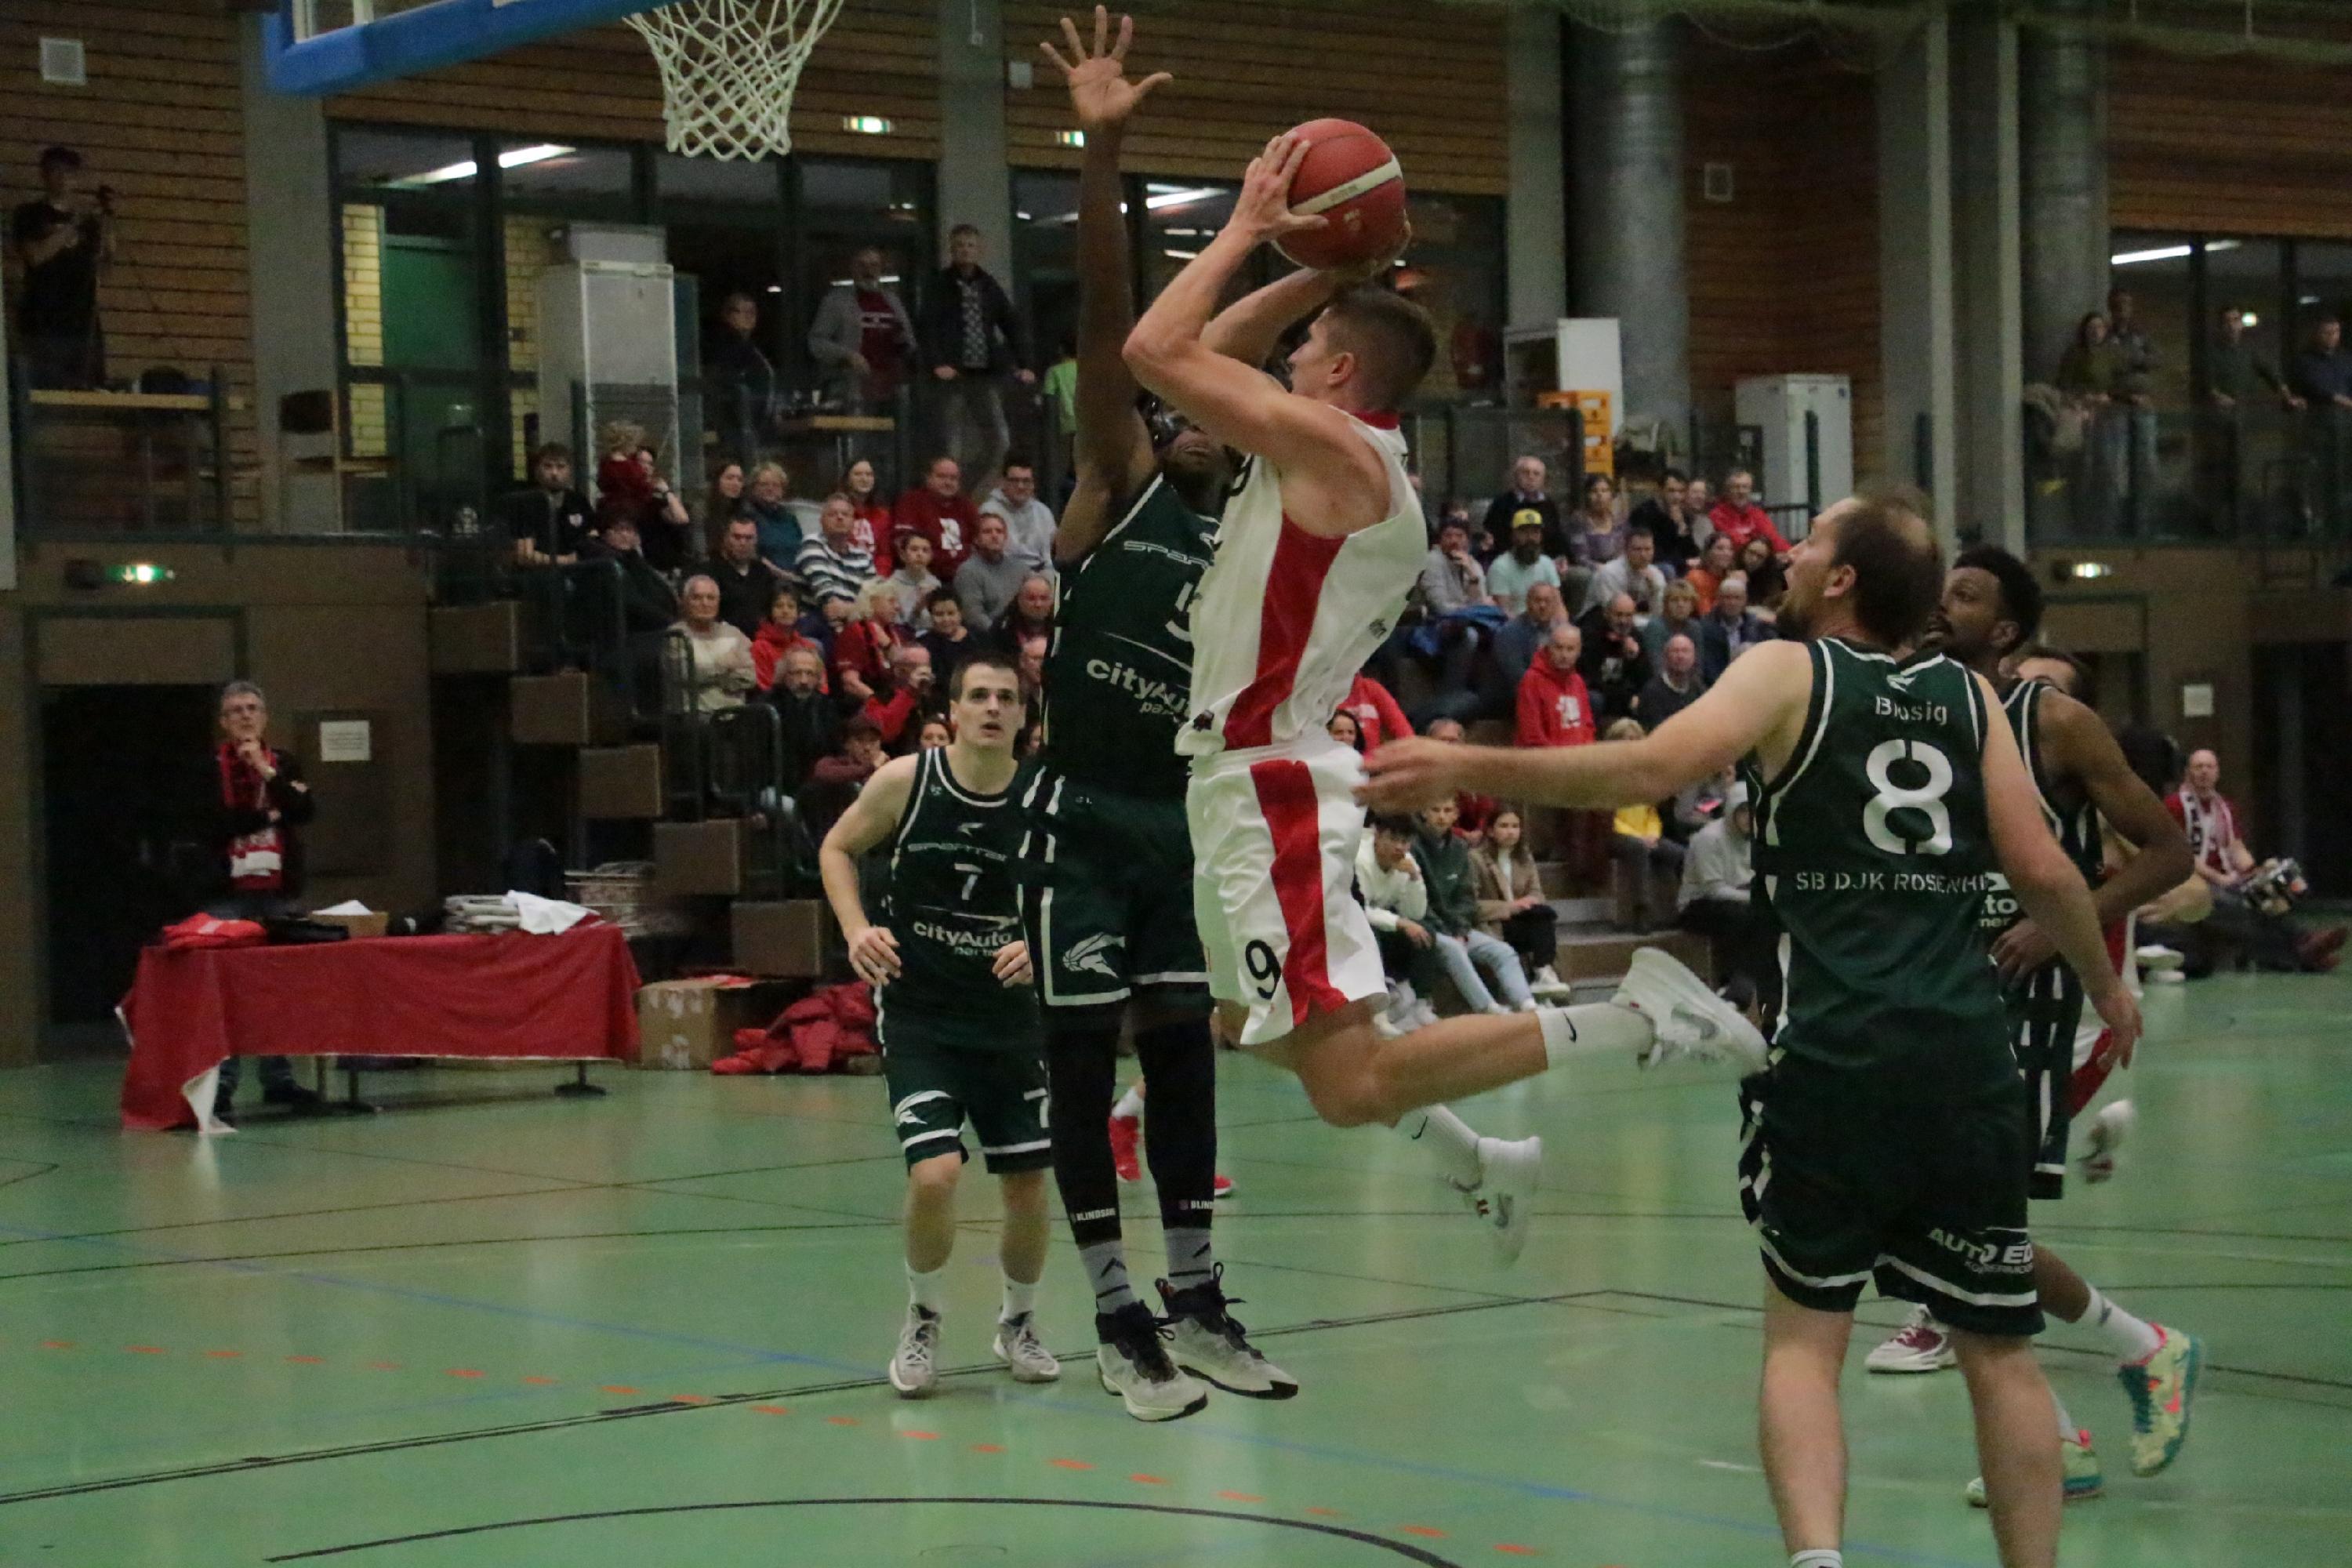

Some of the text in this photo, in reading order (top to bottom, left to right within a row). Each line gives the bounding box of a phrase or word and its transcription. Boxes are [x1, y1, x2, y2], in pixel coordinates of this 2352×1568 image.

[1864, 739, 1953, 855] 8
[954, 863, 982, 900] 7
[1796, 872, 1825, 891] SB
[1835, 872, 1884, 891] DJK
[1245, 939, 1281, 1000] 9
